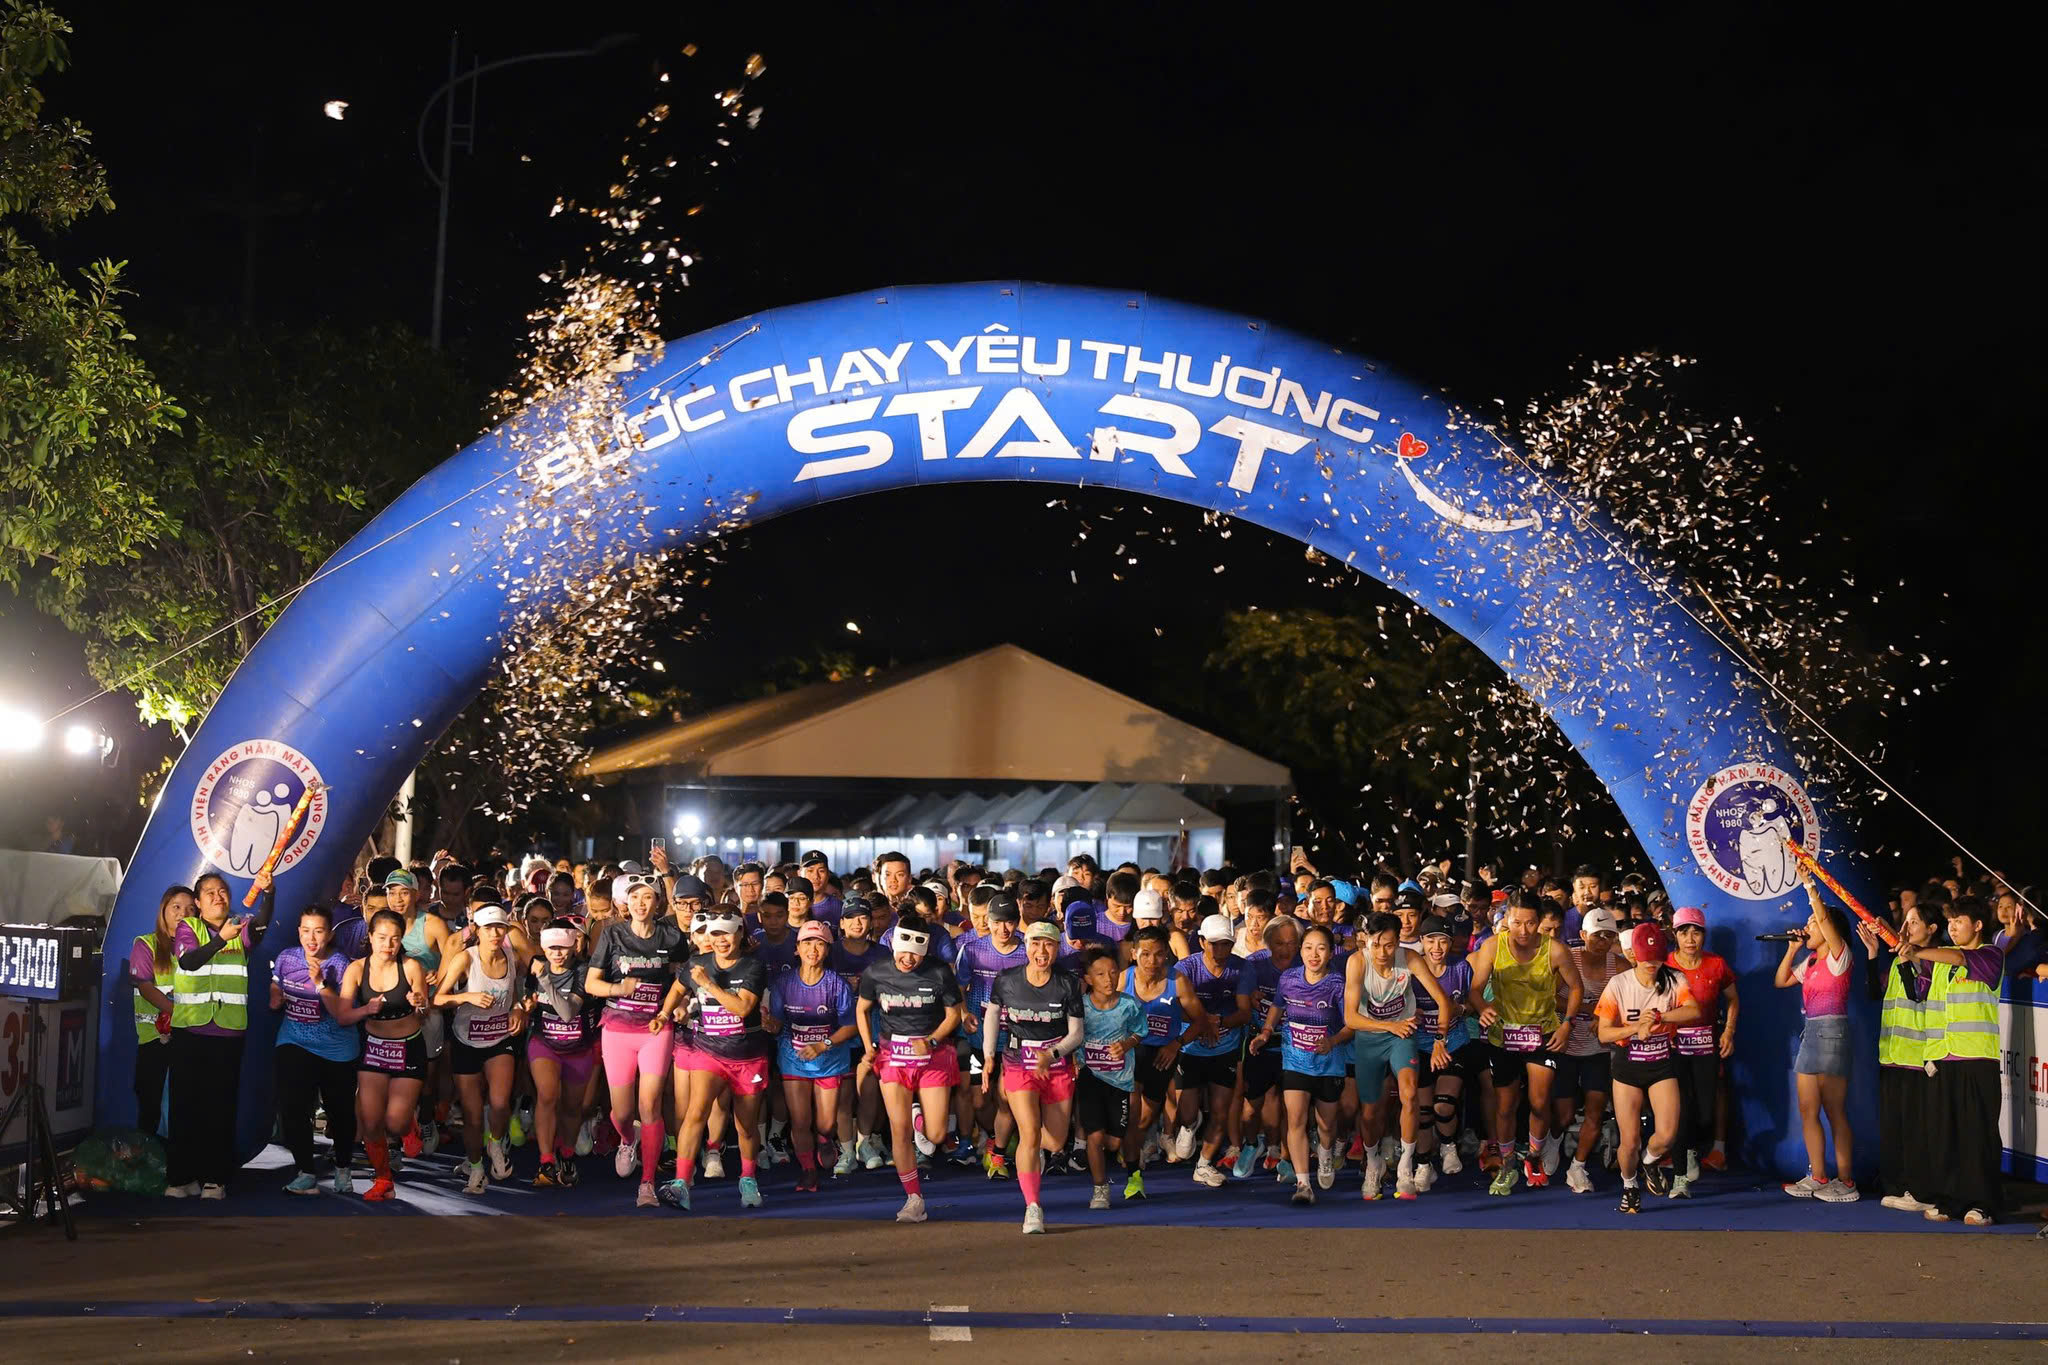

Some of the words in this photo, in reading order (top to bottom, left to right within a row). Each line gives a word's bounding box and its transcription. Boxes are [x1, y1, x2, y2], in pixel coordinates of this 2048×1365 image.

[925, 322, 1071, 377] YÊU
[1081, 340, 1381, 444] THƯƠNG
[787, 385, 1313, 494] START
[207, 751, 240, 783] RĂNG
[307, 776, 324, 823] TUNG
[228, 775, 256, 790] NHOS
[1720, 818, 1742, 828] 1980
[1707, 864, 1741, 892] BỆNH
[544, 1021, 579, 1031] V12217
[705, 1015, 741, 1024] V12216
[369, 1045, 404, 1058] V12144
